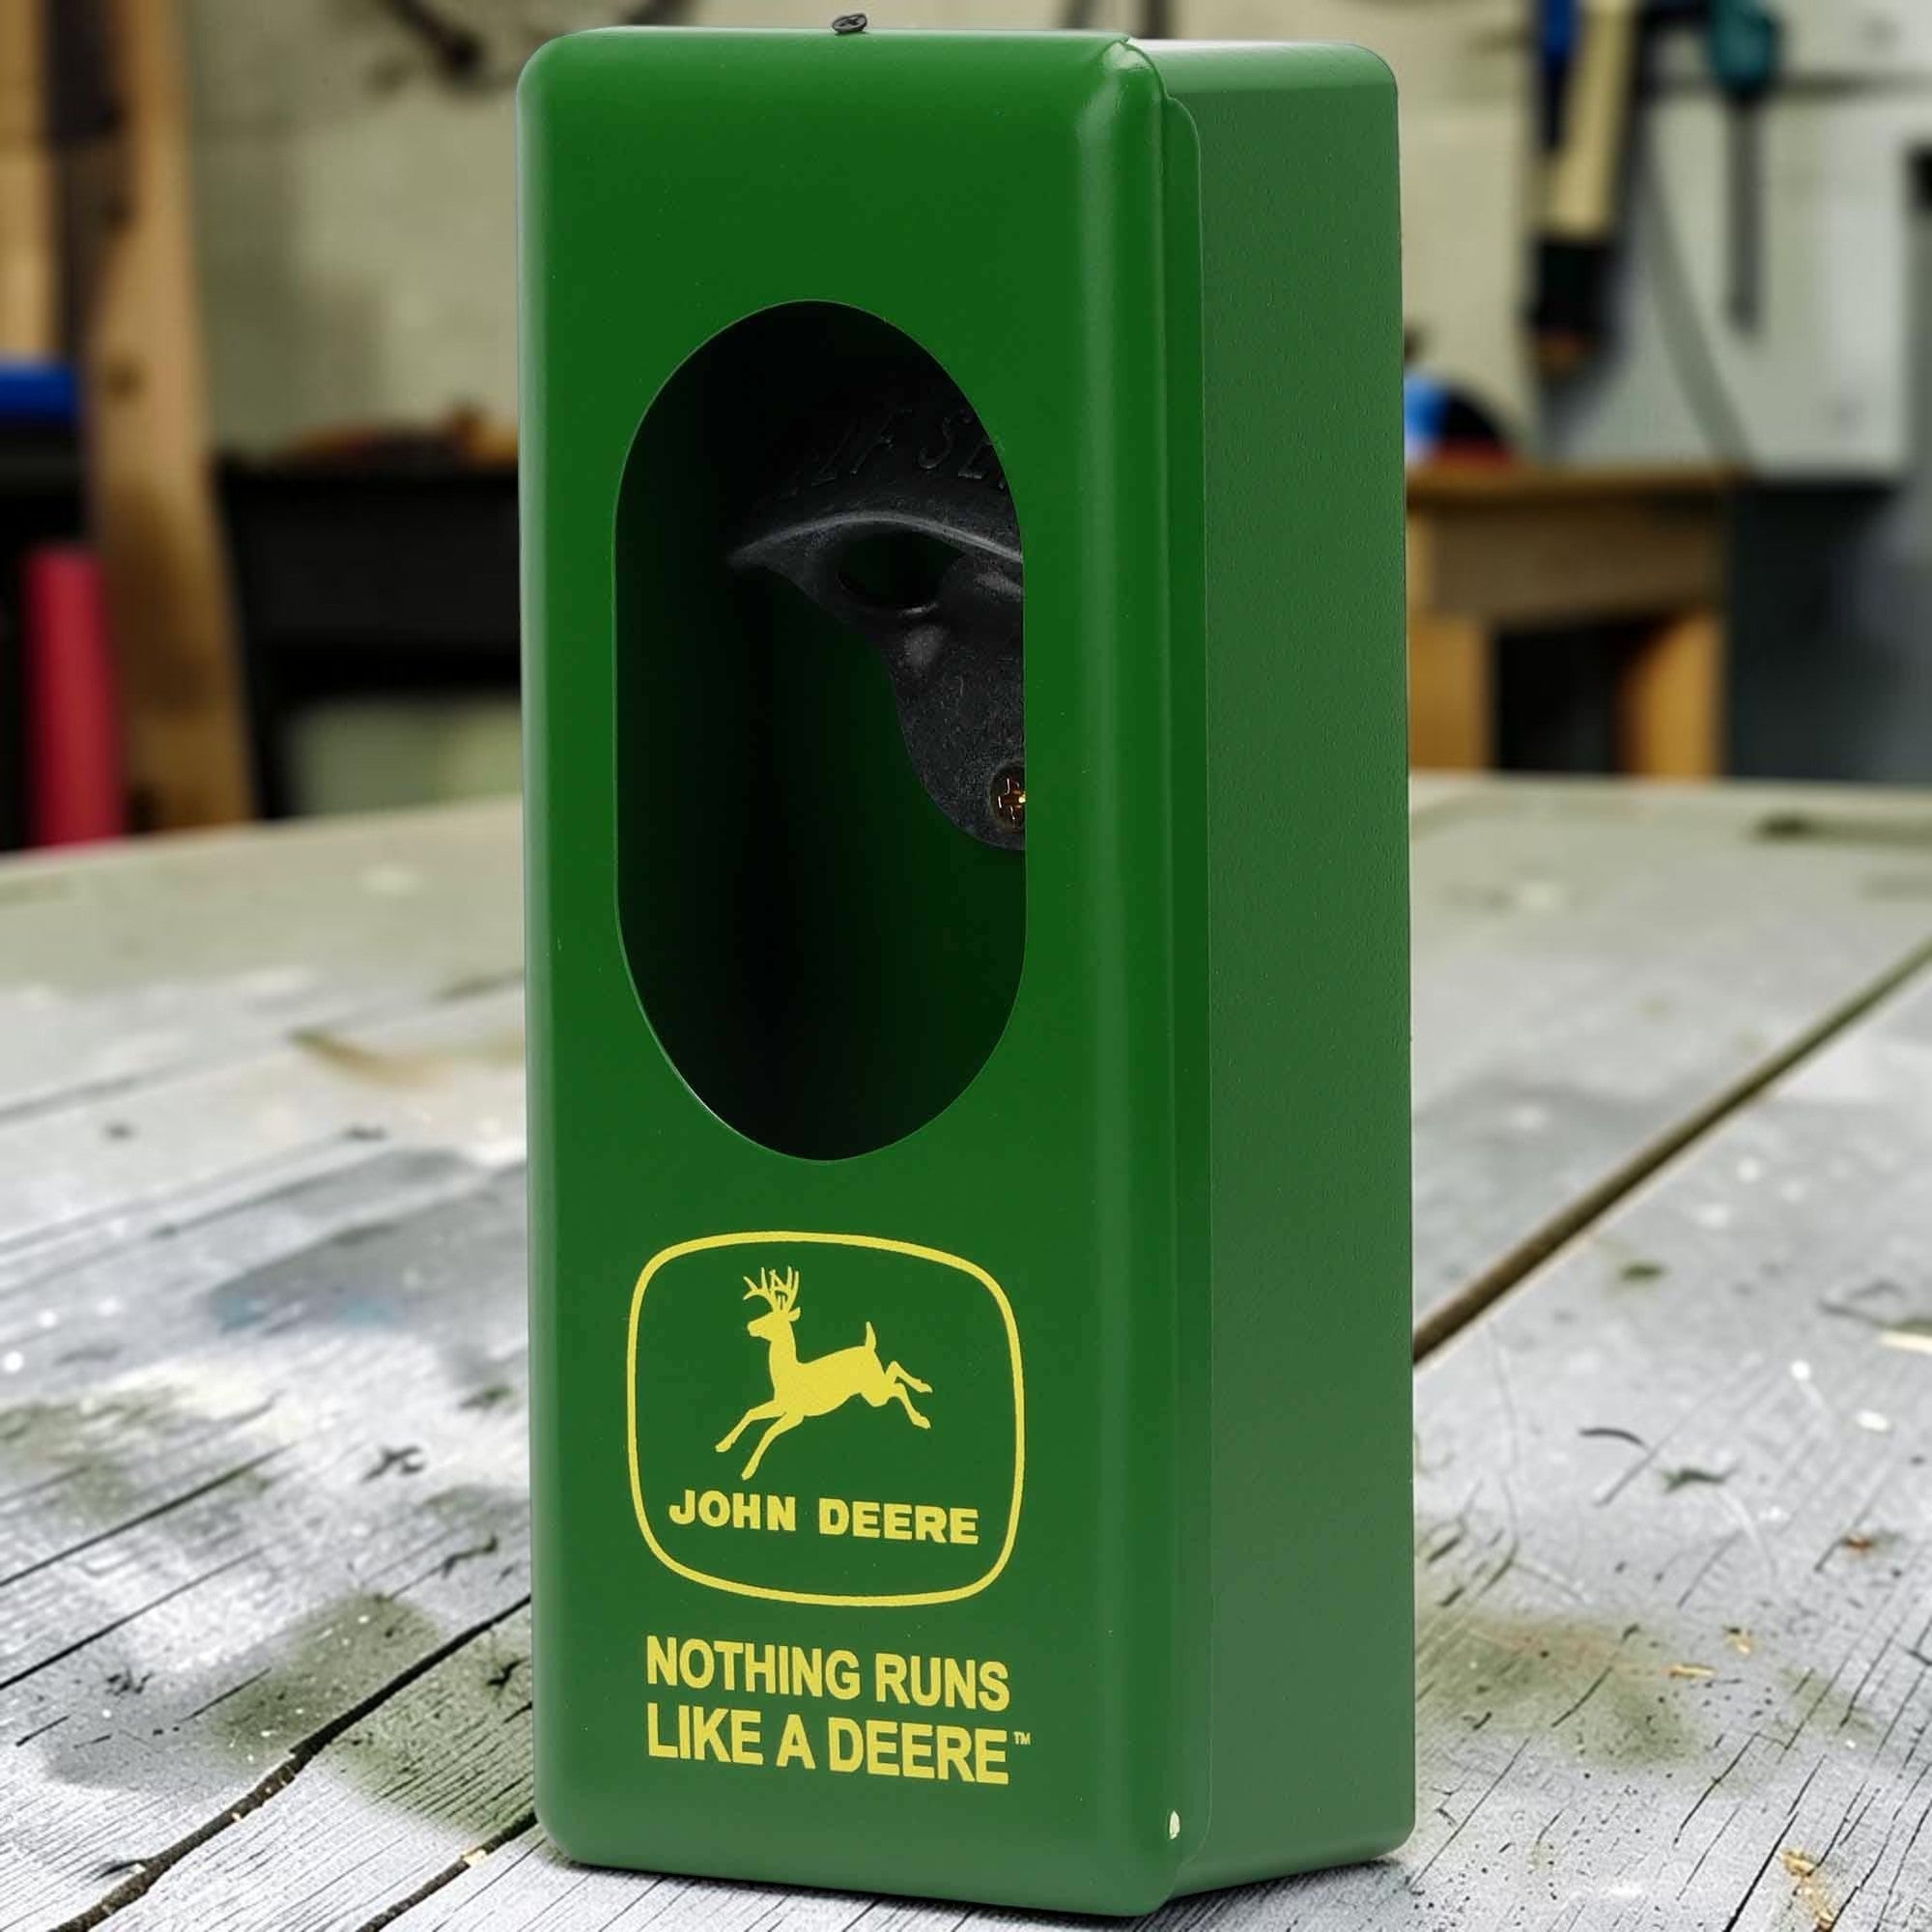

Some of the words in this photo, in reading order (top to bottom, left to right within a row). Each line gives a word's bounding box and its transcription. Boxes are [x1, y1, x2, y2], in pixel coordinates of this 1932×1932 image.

[668, 1489, 797, 1532] JOHN
[818, 1497, 980, 1545] DEERE
[646, 1634, 861, 1700] NOTHING
[875, 1652, 1010, 1712] RUNS
[647, 1702, 764, 1766] LIKE
[776, 1714, 816, 1770] A
[827, 1716, 1009, 1785] DEERE
